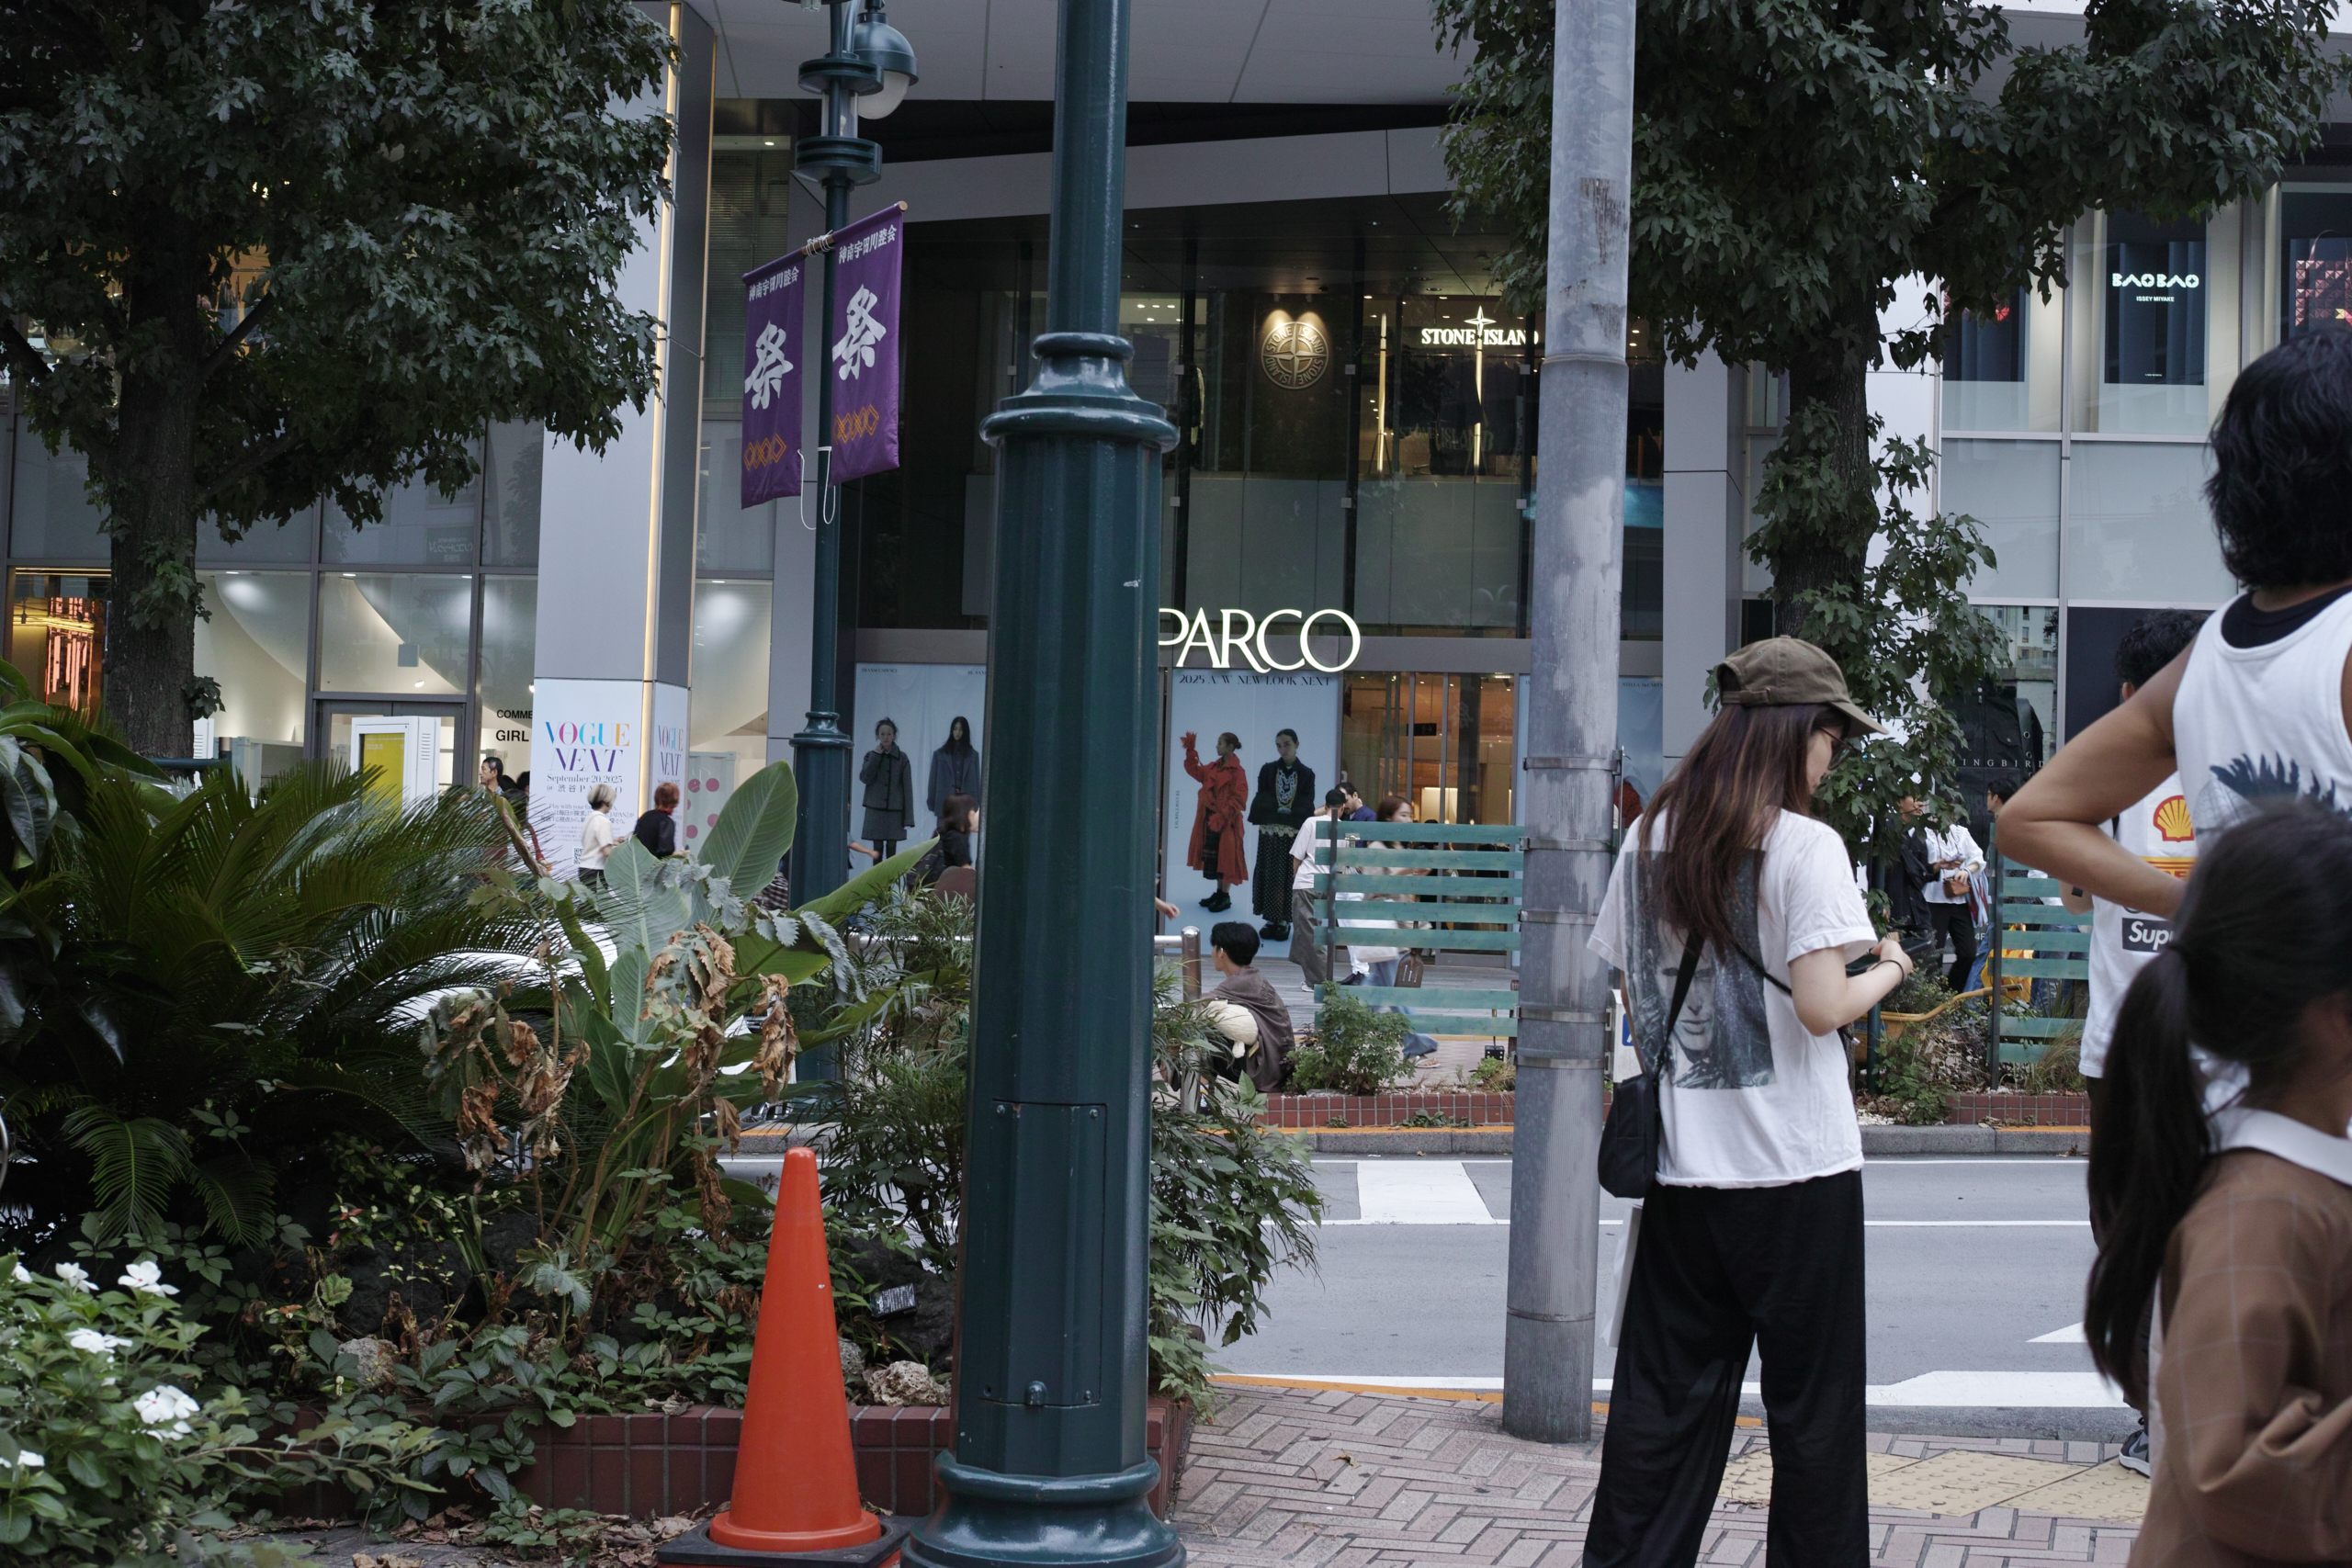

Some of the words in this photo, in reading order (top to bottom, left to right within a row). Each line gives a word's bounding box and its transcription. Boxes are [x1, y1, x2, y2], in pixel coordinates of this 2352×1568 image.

[831, 283, 887, 381] 祭
[1266, 326, 1293, 353] STONE
[1298, 325, 1325, 354] ISLAND
[1421, 328, 1476, 345] STONE
[744, 320, 794, 410] 祭
[1265, 357, 1292, 385] ISLAND
[1296, 358, 1324, 386] STONE
[1179, 674, 1205, 684] 2025
[1238, 675, 1263, 685] NEW
[1266, 675, 1296, 685] LOOK
[1301, 676, 1331, 686] NEXT
[496, 709, 533, 719] COMME
[545, 721, 630, 747] VOGUE
[658, 725, 684, 751] VOGUE
[549, 748, 624, 772] NEXT
[660, 751, 682, 776] NEXT
[547, 773, 590, 784] September
[604, 775, 623, 784] 2025
